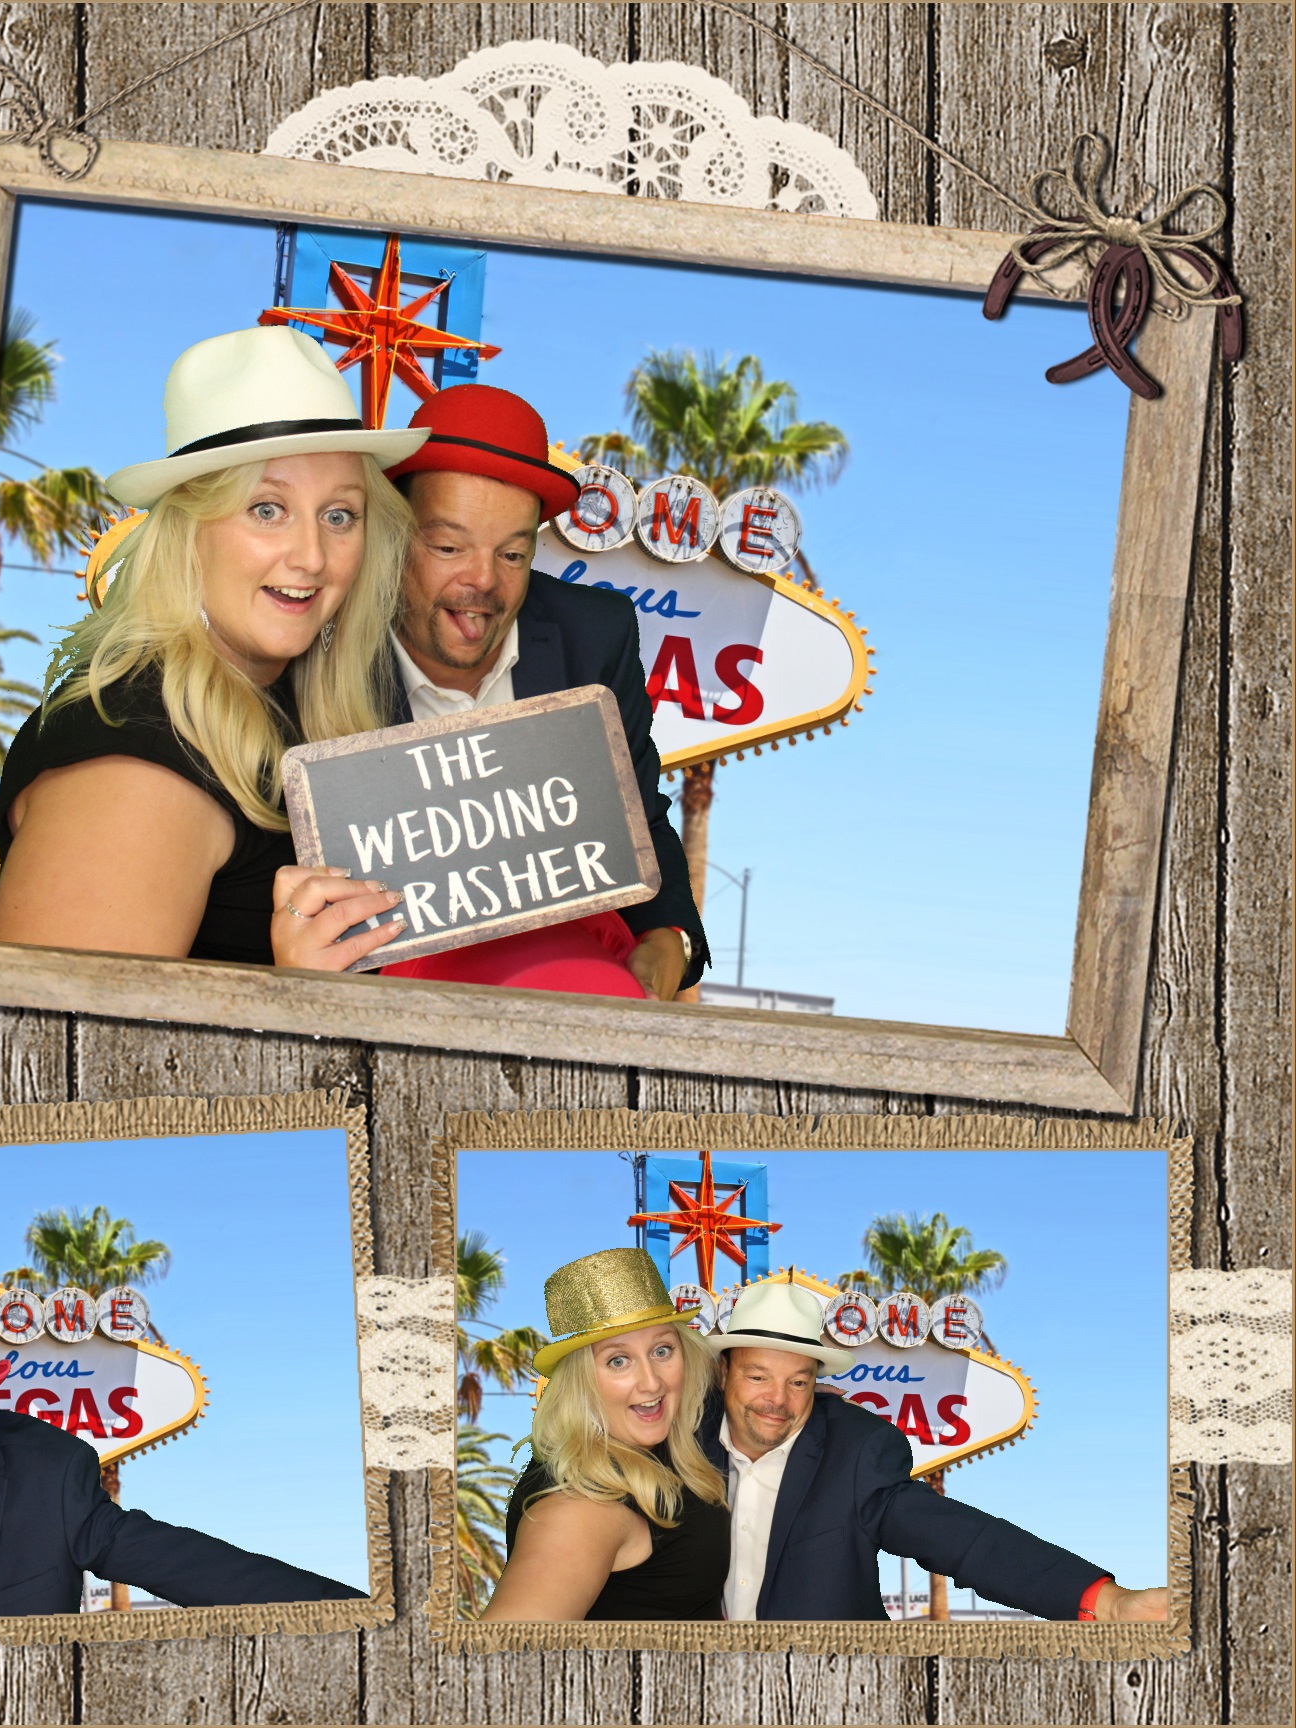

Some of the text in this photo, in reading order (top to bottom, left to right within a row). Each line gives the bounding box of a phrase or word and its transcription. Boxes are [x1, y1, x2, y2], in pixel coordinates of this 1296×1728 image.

[406, 733, 503, 791] THE
[348, 776, 579, 873] WEDDING
[366, 841, 617, 934] RASHER
